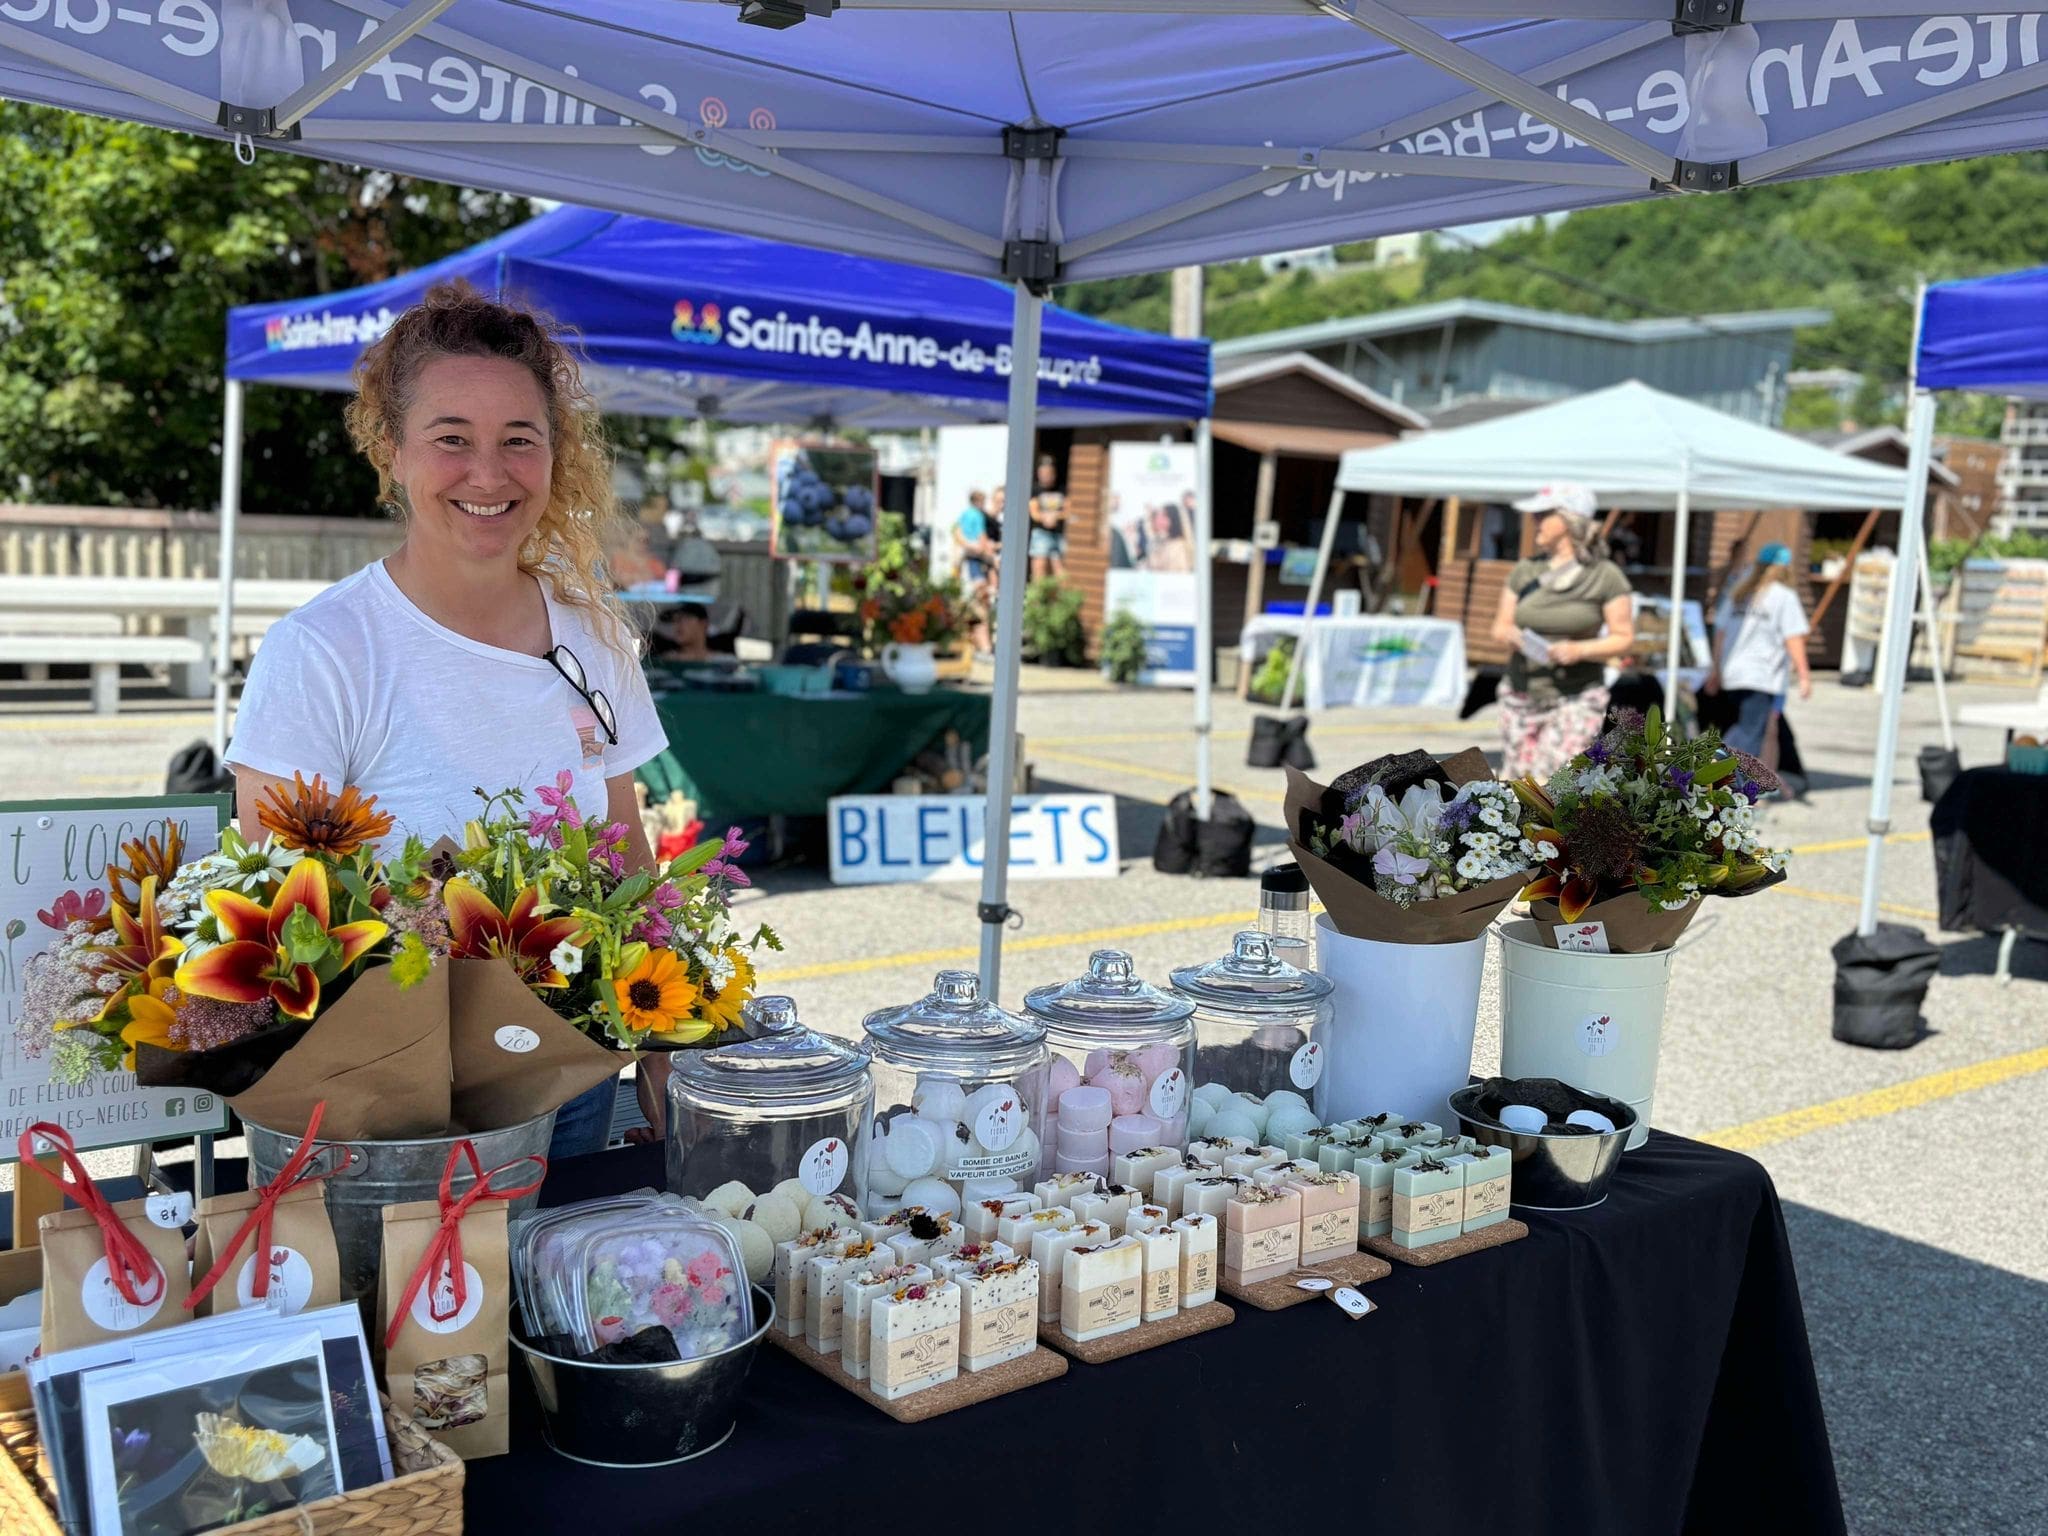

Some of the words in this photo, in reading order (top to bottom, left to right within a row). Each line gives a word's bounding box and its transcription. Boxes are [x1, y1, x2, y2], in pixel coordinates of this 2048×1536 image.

[726, 305, 1102, 389] Sainte-Anne-de-Baupré
[9, 1086, 26, 1108] DE
[37, 1079, 94, 1104] FLEURS
[962, 1157, 991, 1167] BOMBE
[993, 1157, 1004, 1165] DE
[1005, 1153, 1021, 1163] BAIN
[950, 1171, 985, 1179] VAPEUR
[986, 1169, 998, 1177] DE
[999, 1164, 1025, 1176] DOUCHE
